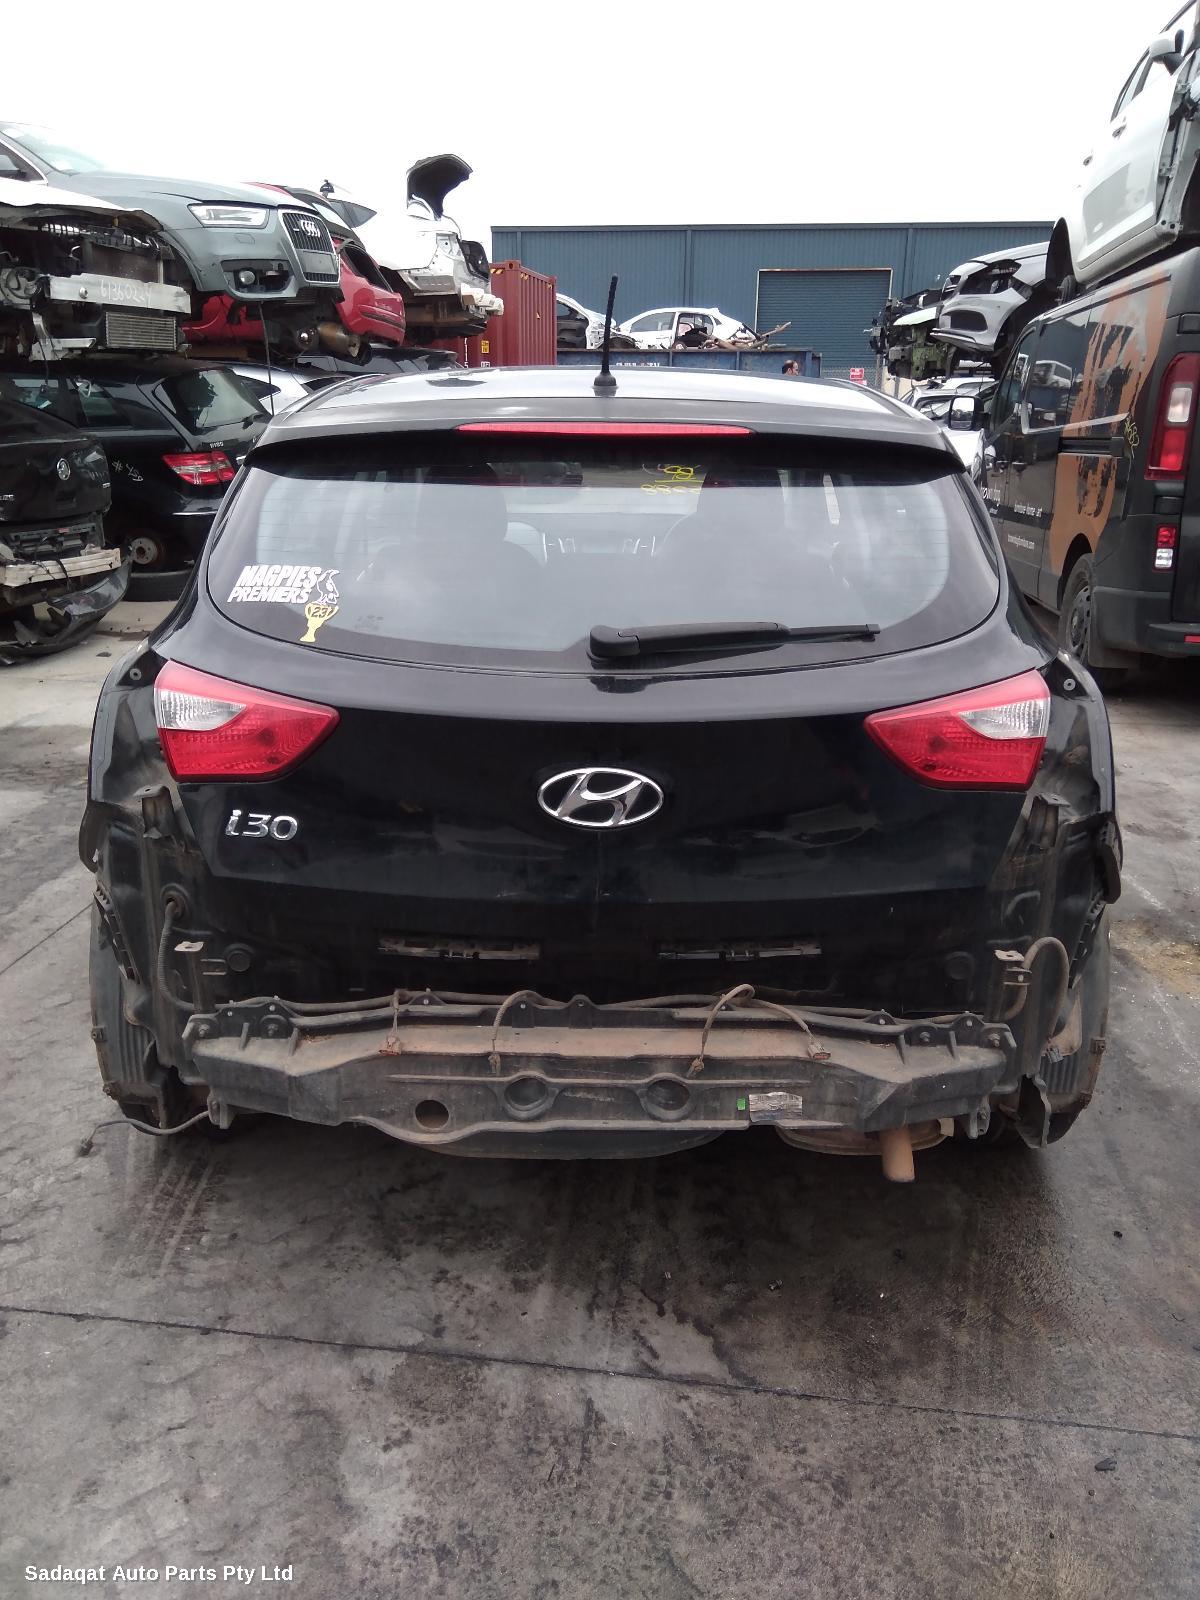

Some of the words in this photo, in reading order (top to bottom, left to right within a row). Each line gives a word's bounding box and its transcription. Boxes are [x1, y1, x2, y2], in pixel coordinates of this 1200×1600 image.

[235, 565, 322, 589] MAGPIES
[227, 586, 312, 604] PREMIERS
[225, 809, 298, 841] i30
